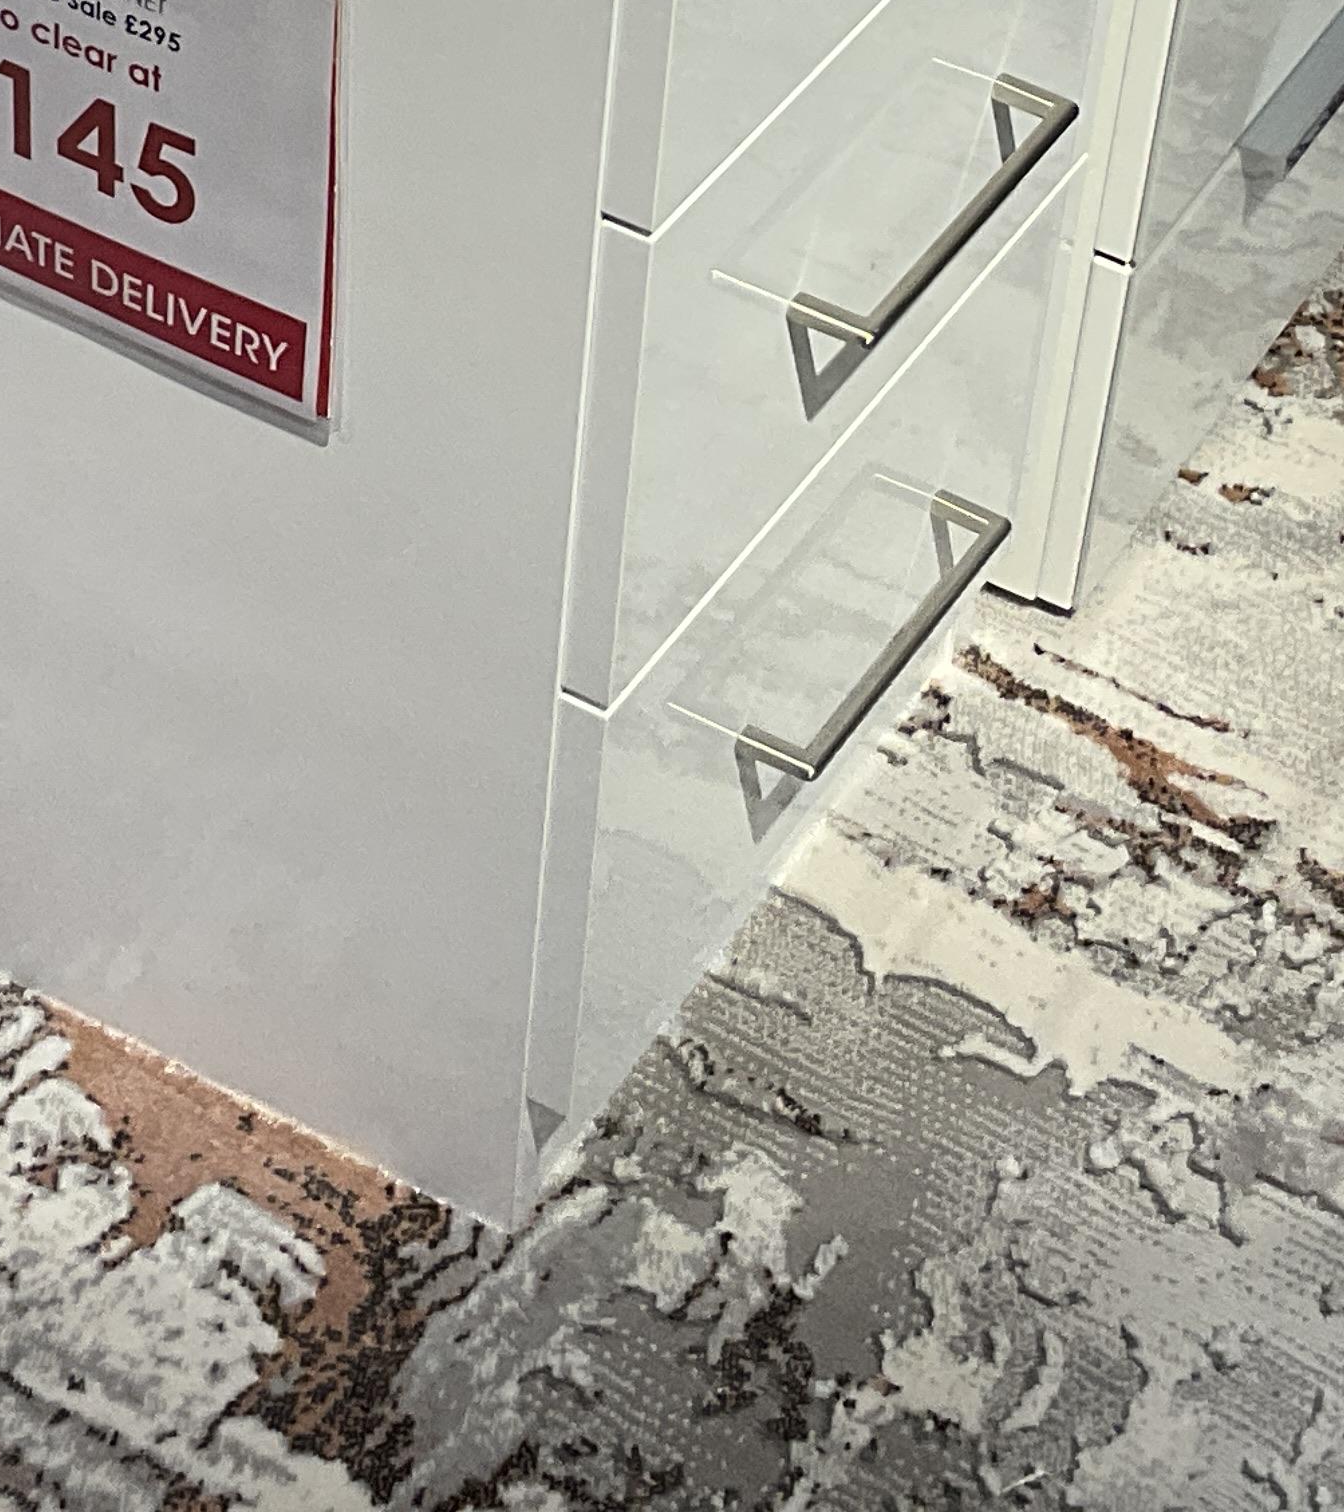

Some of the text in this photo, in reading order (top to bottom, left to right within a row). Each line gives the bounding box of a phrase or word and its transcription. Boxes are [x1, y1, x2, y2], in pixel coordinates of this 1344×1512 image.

[31, 23, 117, 72] clear
[128, 62, 162, 92] at
[124, 14, 182, 52] £295
[91, 257, 289, 373] DELIVERY
